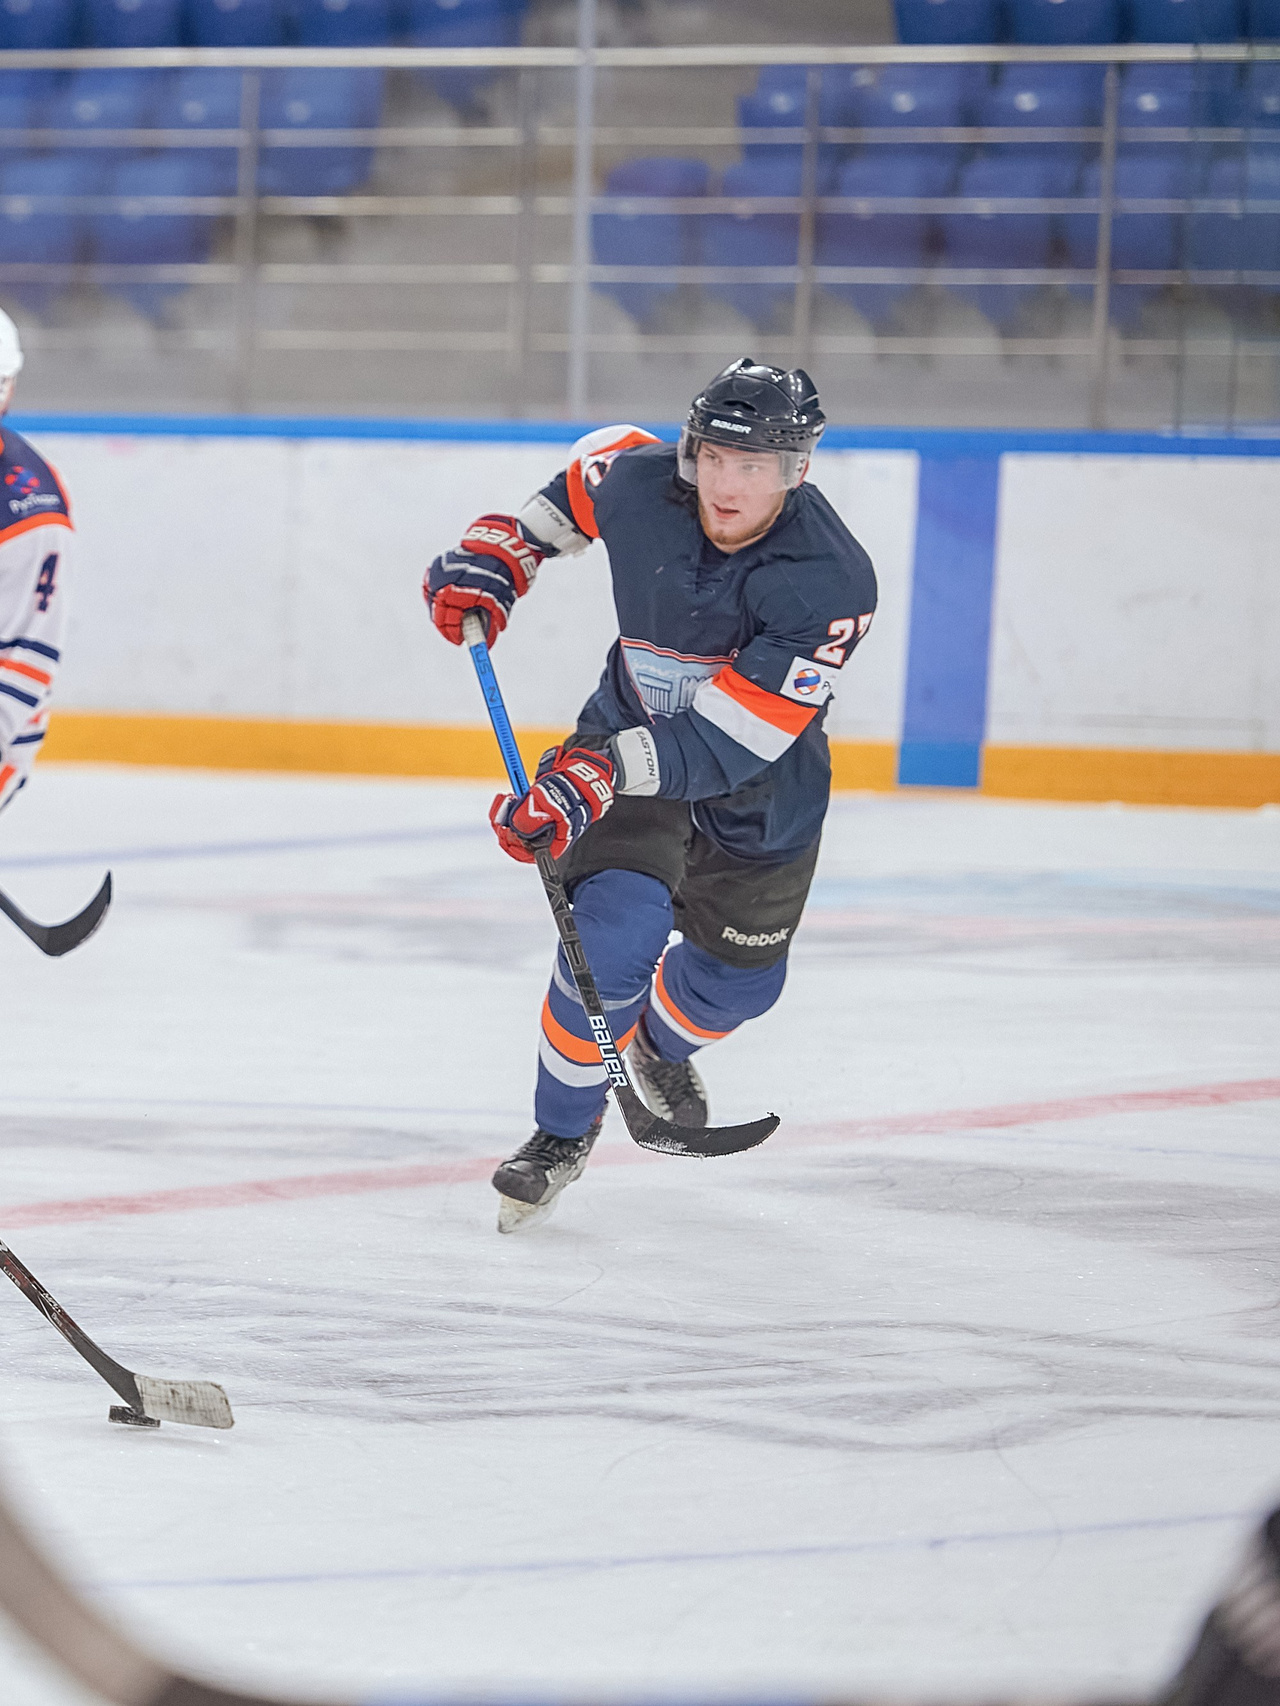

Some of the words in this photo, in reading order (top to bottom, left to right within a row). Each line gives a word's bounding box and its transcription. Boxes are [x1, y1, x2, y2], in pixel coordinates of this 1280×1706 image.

[710, 418, 752, 434] BAUER
[34, 552, 58, 613] 4
[463, 525, 537, 587] BAUE
[534, 848, 591, 977] EXUS
[721, 925, 791, 948] Reebok
[588, 1015, 629, 1088] BAUER
